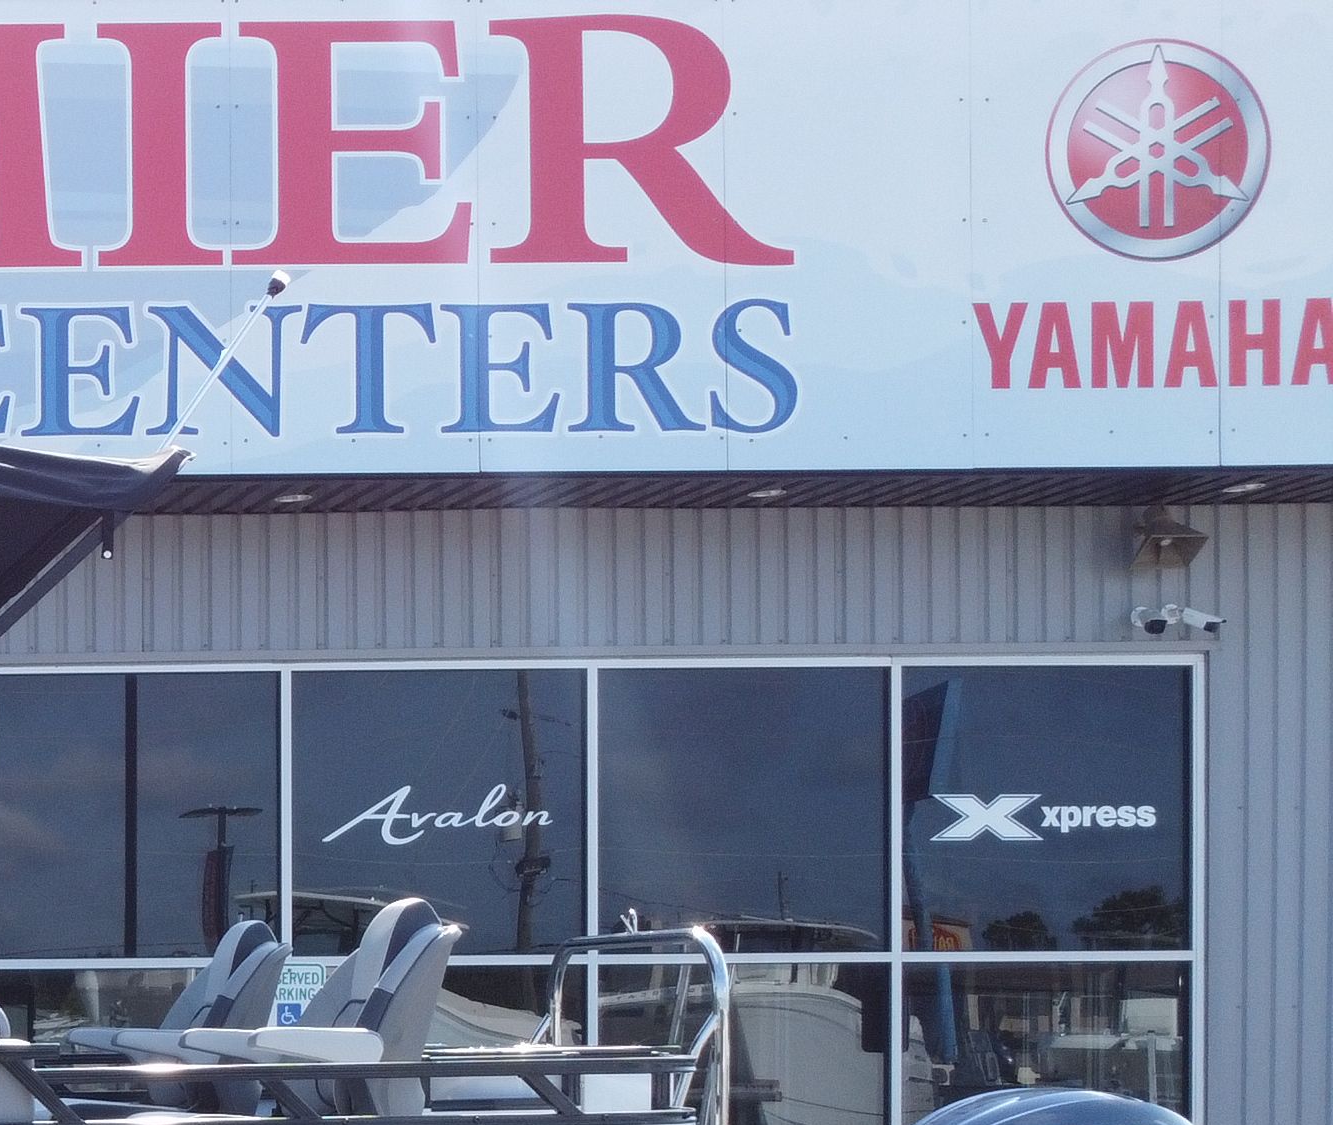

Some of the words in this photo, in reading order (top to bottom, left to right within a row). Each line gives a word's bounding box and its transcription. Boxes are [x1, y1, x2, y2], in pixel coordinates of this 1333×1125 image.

[972, 297, 1333, 390] YAMAHA
[322, 783, 553, 845] Avalon
[1040, 805, 1156, 833] xpress
